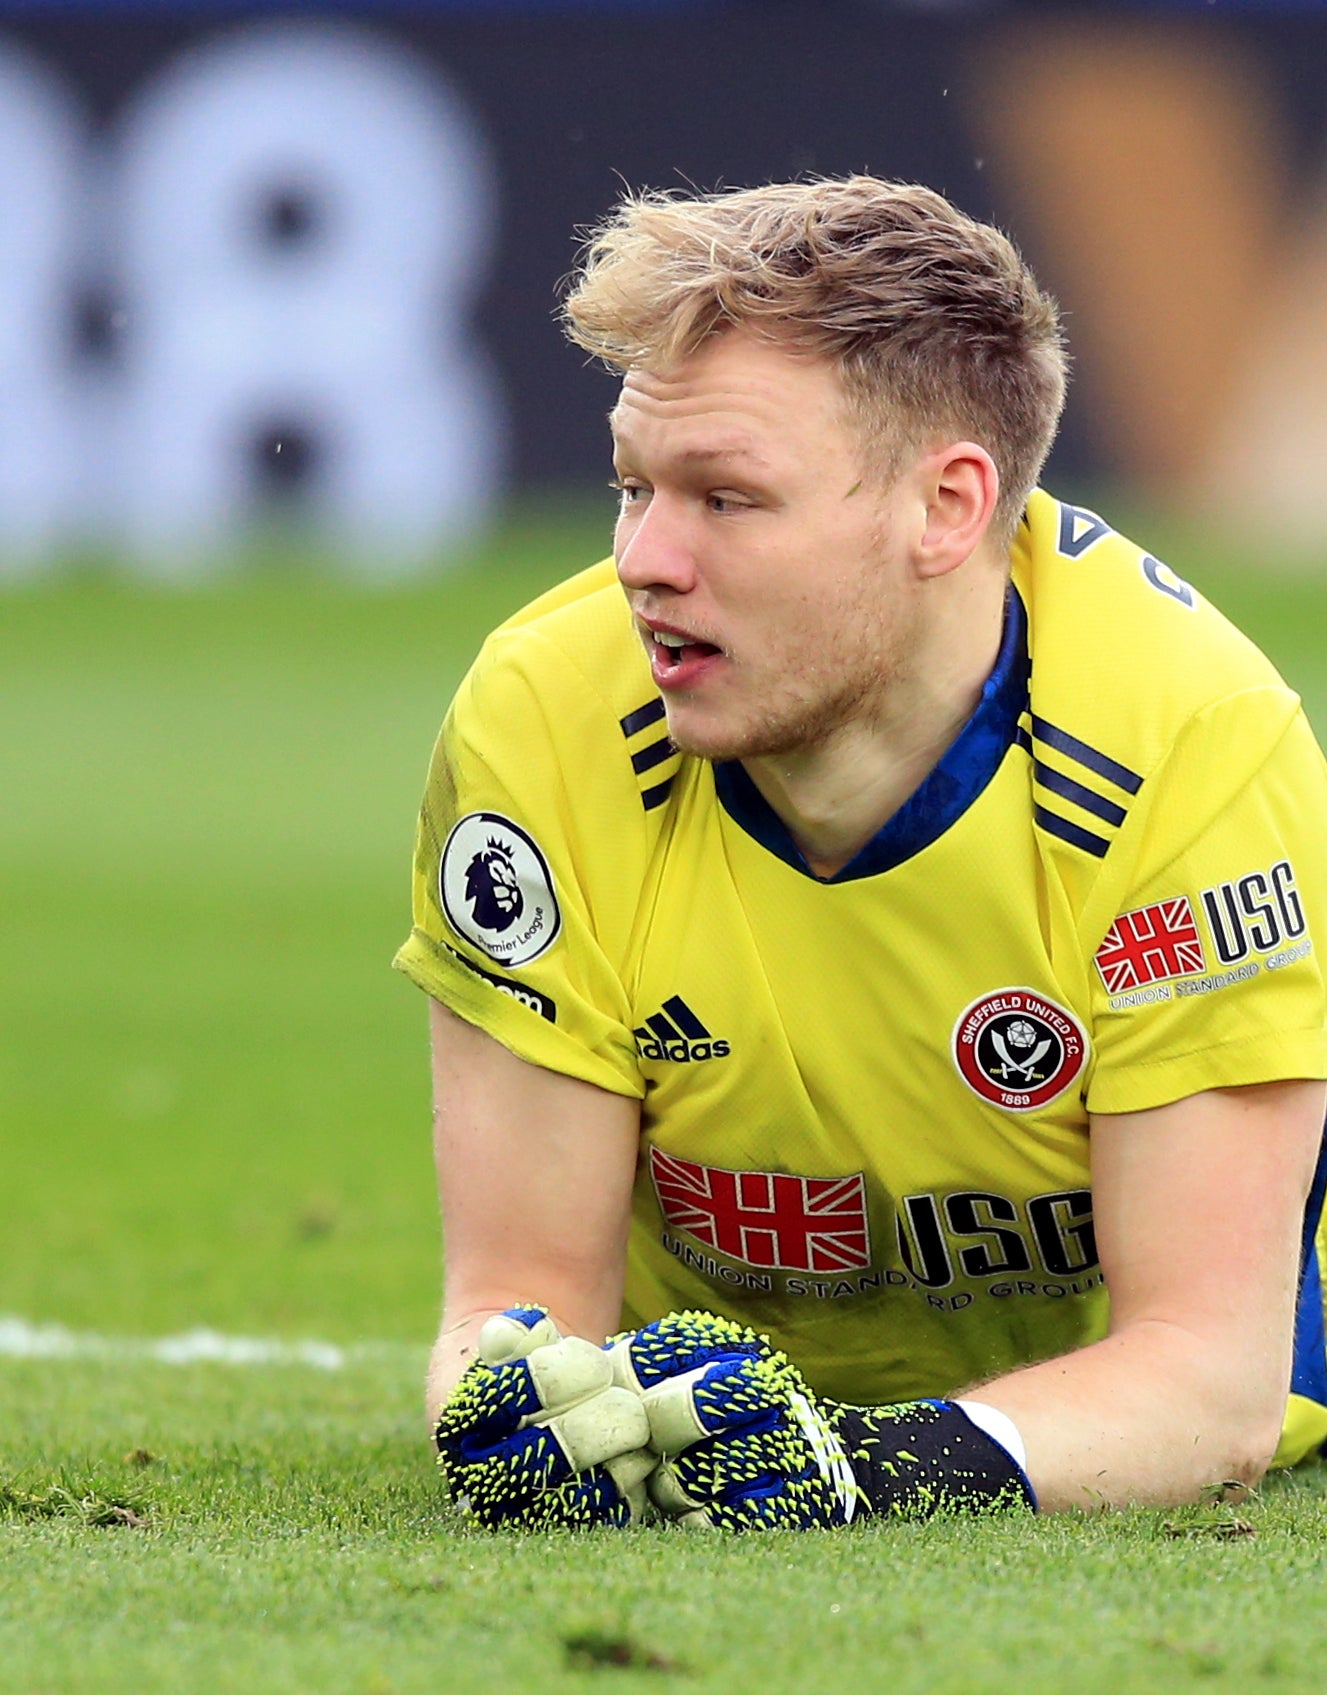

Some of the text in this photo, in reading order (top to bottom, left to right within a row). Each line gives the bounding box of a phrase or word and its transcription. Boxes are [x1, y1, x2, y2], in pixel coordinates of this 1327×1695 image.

[516, 906, 544, 945] League
[1200, 860, 1306, 966] USG
[1109, 984, 1171, 1010] UNION
[1174, 963, 1260, 999] STANDARD
[961, 996, 1022, 1045] SHEFFIELD
[1026, 998, 1071, 1035] UNITED
[634, 1039, 731, 1063] didas
[1000, 1092, 1031, 1106] 1889
[895, 1189, 1100, 1290] USG
[661, 1231, 1105, 1312] UNION STANDRD GROU
